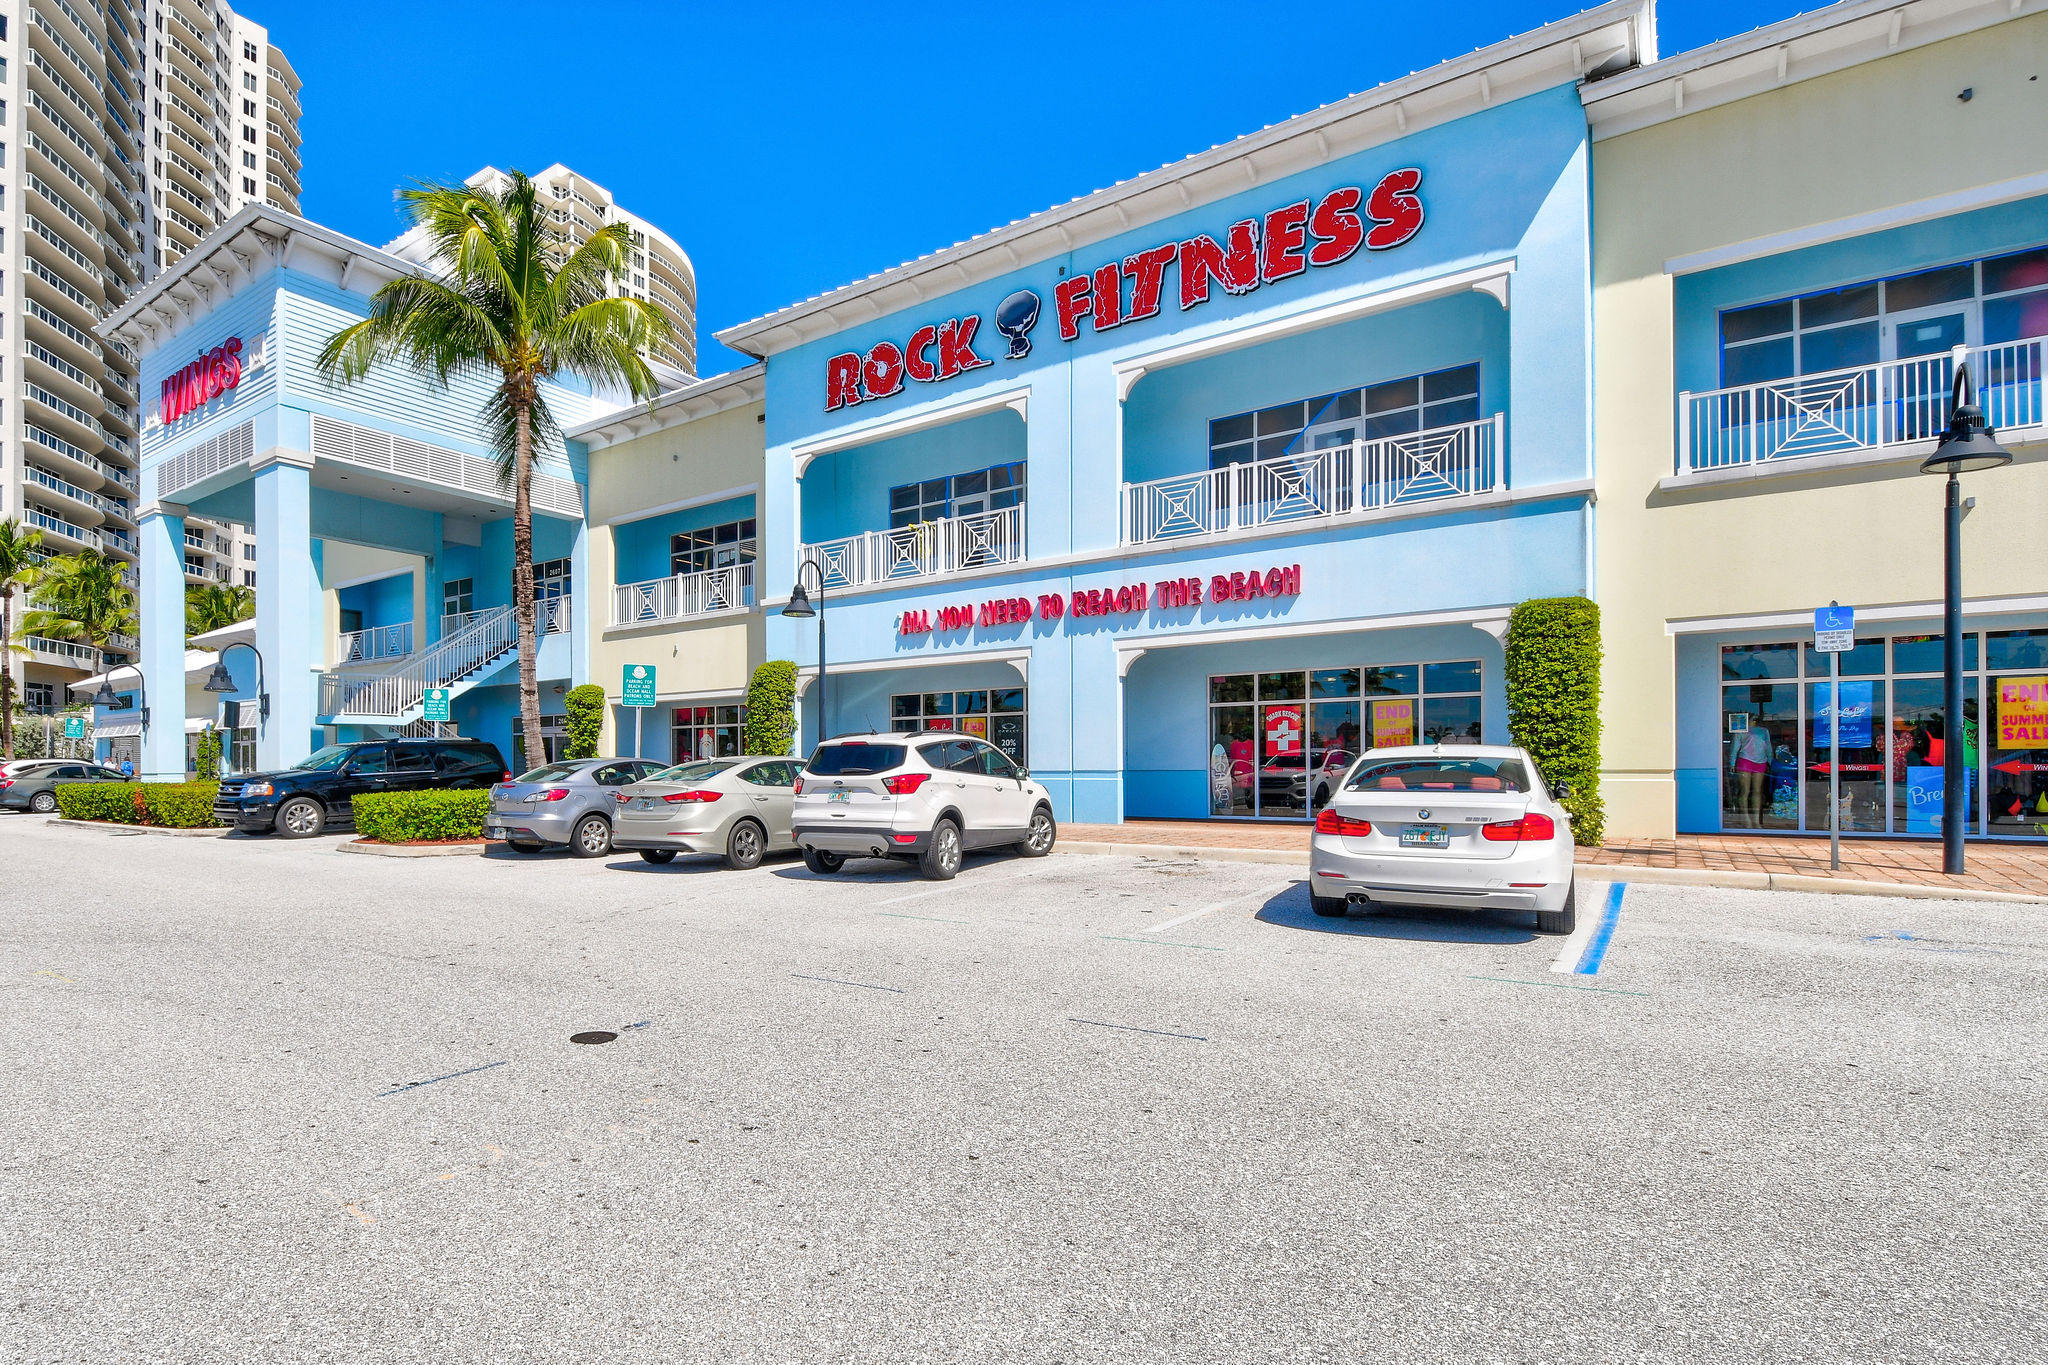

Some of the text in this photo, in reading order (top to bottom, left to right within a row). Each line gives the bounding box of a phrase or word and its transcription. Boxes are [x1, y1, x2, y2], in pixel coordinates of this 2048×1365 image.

[824, 167, 1425, 412] ROCK FITNESS
[161, 336, 242, 425] WINGS
[900, 564, 1302, 635] ALL YOU NEED TO REACH THE BEACH
[1266, 710, 1300, 722] SHARK RESCUE
[1376, 705, 1411, 720] END
[1376, 728, 1410, 737] SUMMER
[1002, 738, 1016, 747] 20%
[1376, 736, 1412, 747] SALE!
